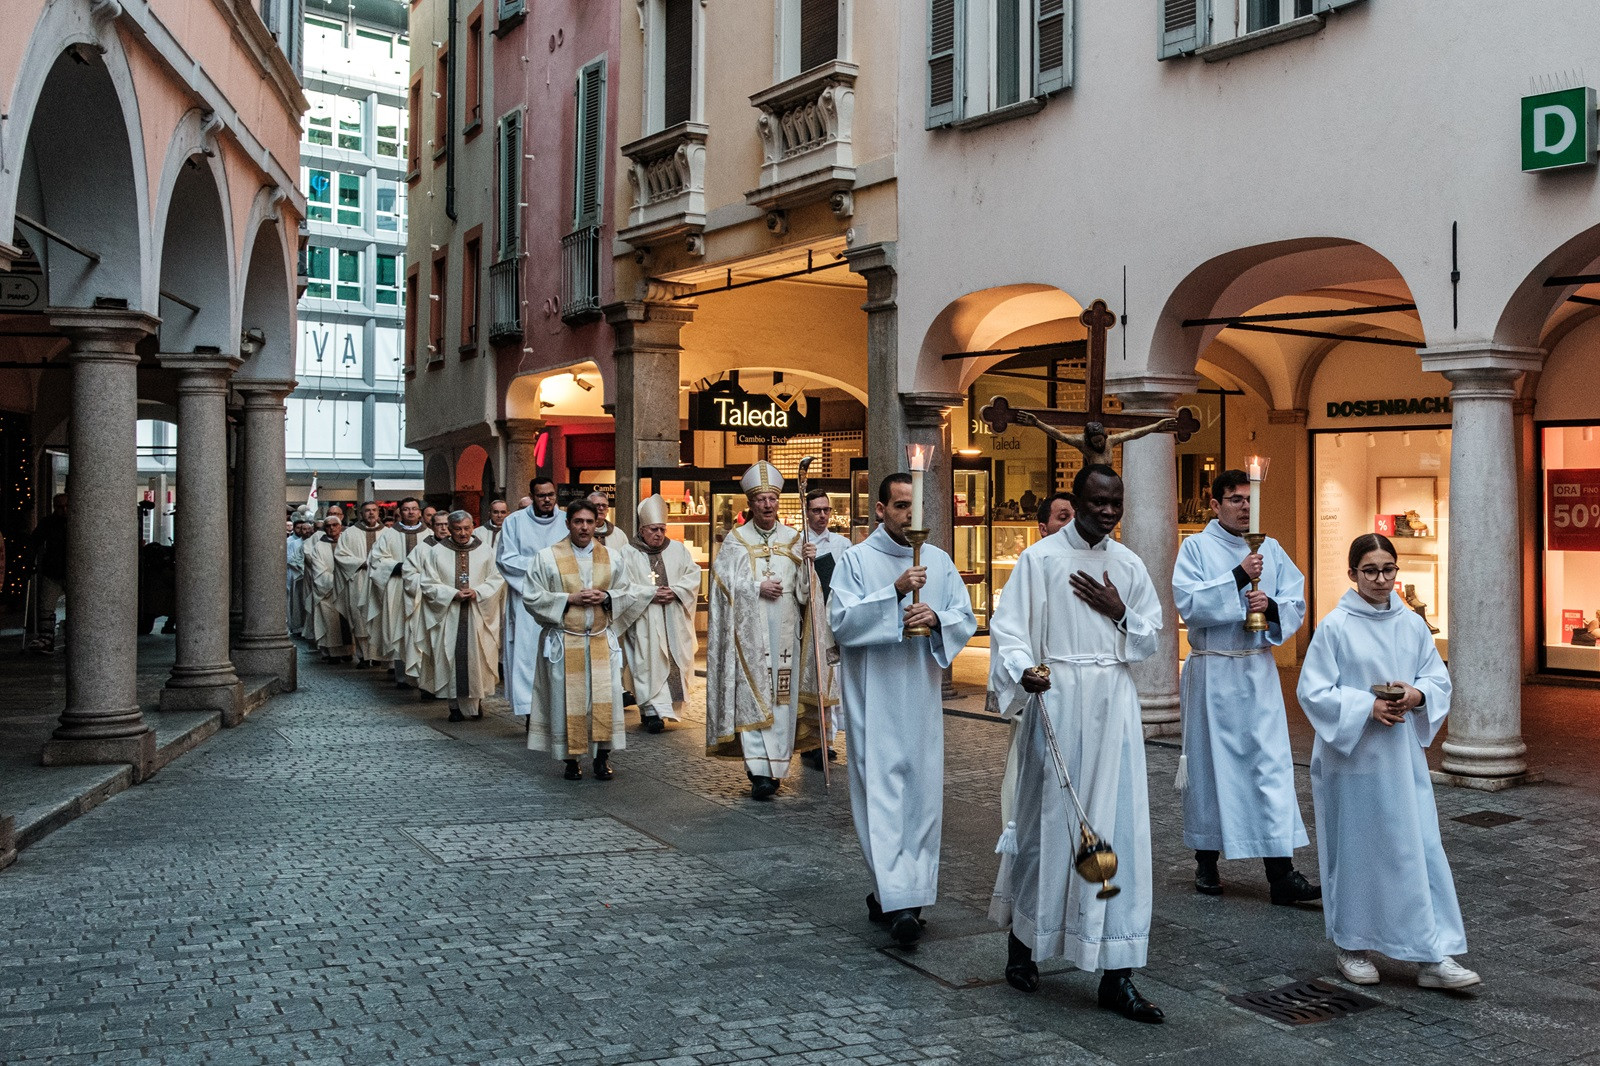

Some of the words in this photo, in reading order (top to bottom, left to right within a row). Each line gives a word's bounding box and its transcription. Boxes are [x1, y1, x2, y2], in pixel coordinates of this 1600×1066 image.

[1533, 104, 1577, 155] D
[713, 397, 788, 428] Taleda
[738, 434, 766, 444] Cambio
[990, 436, 1021, 451] Taleda
[1556, 486, 1578, 495] ORA
